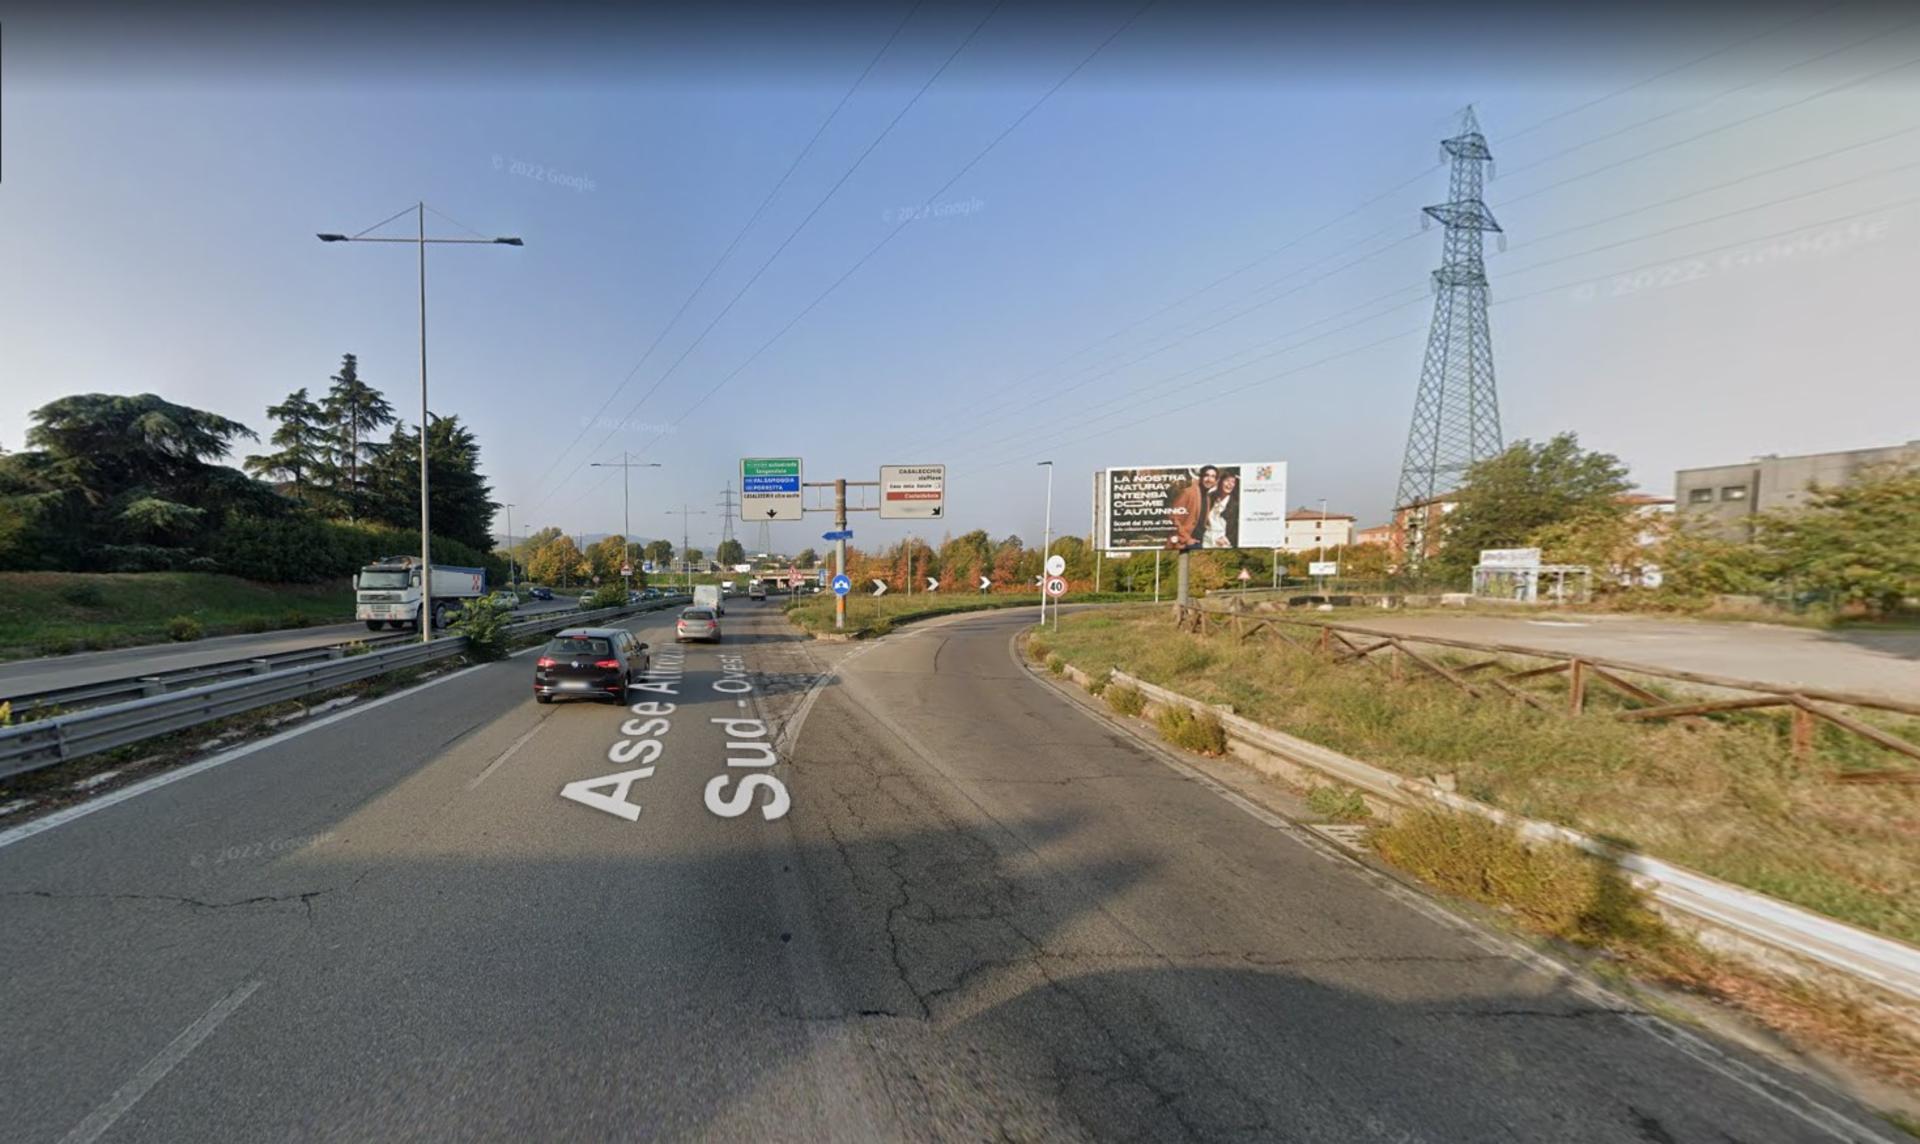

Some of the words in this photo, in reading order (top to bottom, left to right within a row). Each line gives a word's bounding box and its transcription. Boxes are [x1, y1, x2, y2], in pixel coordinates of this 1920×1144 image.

[1133, 474, 1187, 482] NOSTRA
[1113, 483, 1171, 491] NATURA?
[1113, 491, 1168, 499] INTENSA
[1113, 499, 1164, 508] COME
[1113, 506, 1189, 516] L'AUTUNNO.
[1050, 582, 1063, 591] 40
